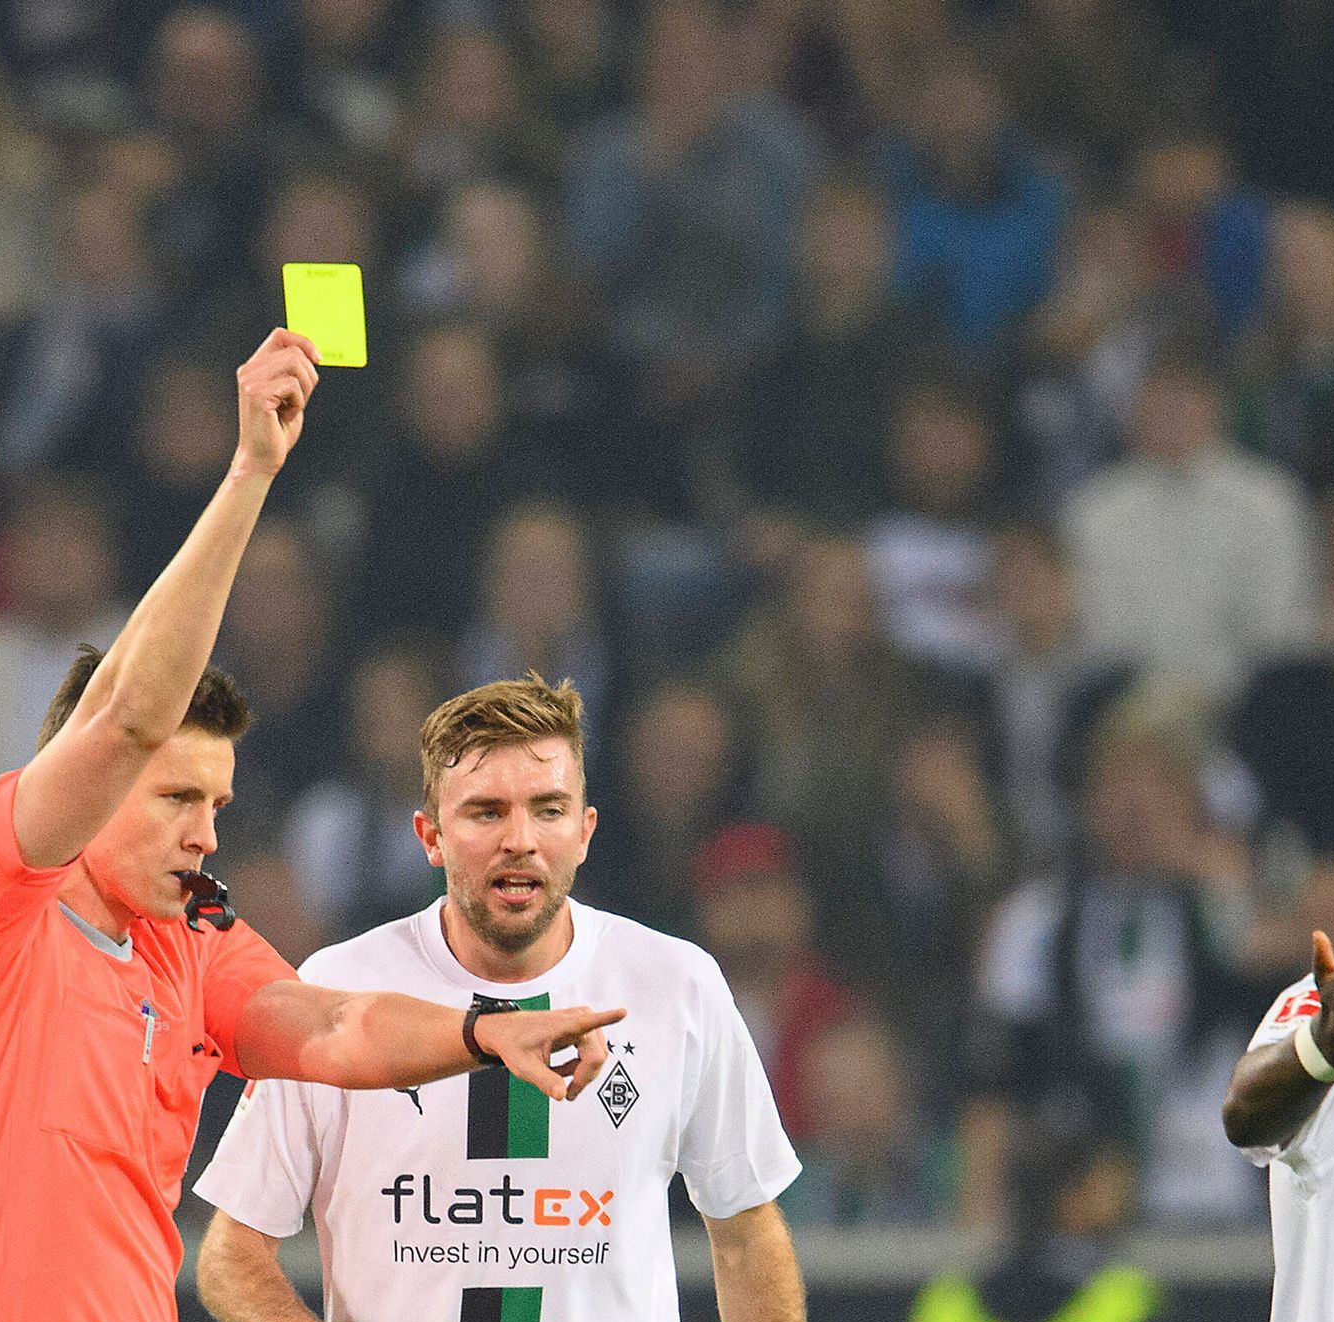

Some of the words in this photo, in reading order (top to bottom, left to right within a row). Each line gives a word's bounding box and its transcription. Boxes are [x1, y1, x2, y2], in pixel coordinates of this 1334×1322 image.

[611, 1082, 628, 1106] B
[381, 1174, 614, 1227] flatex
[393, 1240, 469, 1263] Invest
[478, 1241, 499, 1263] in
[508, 1242, 610, 1270] yourself
